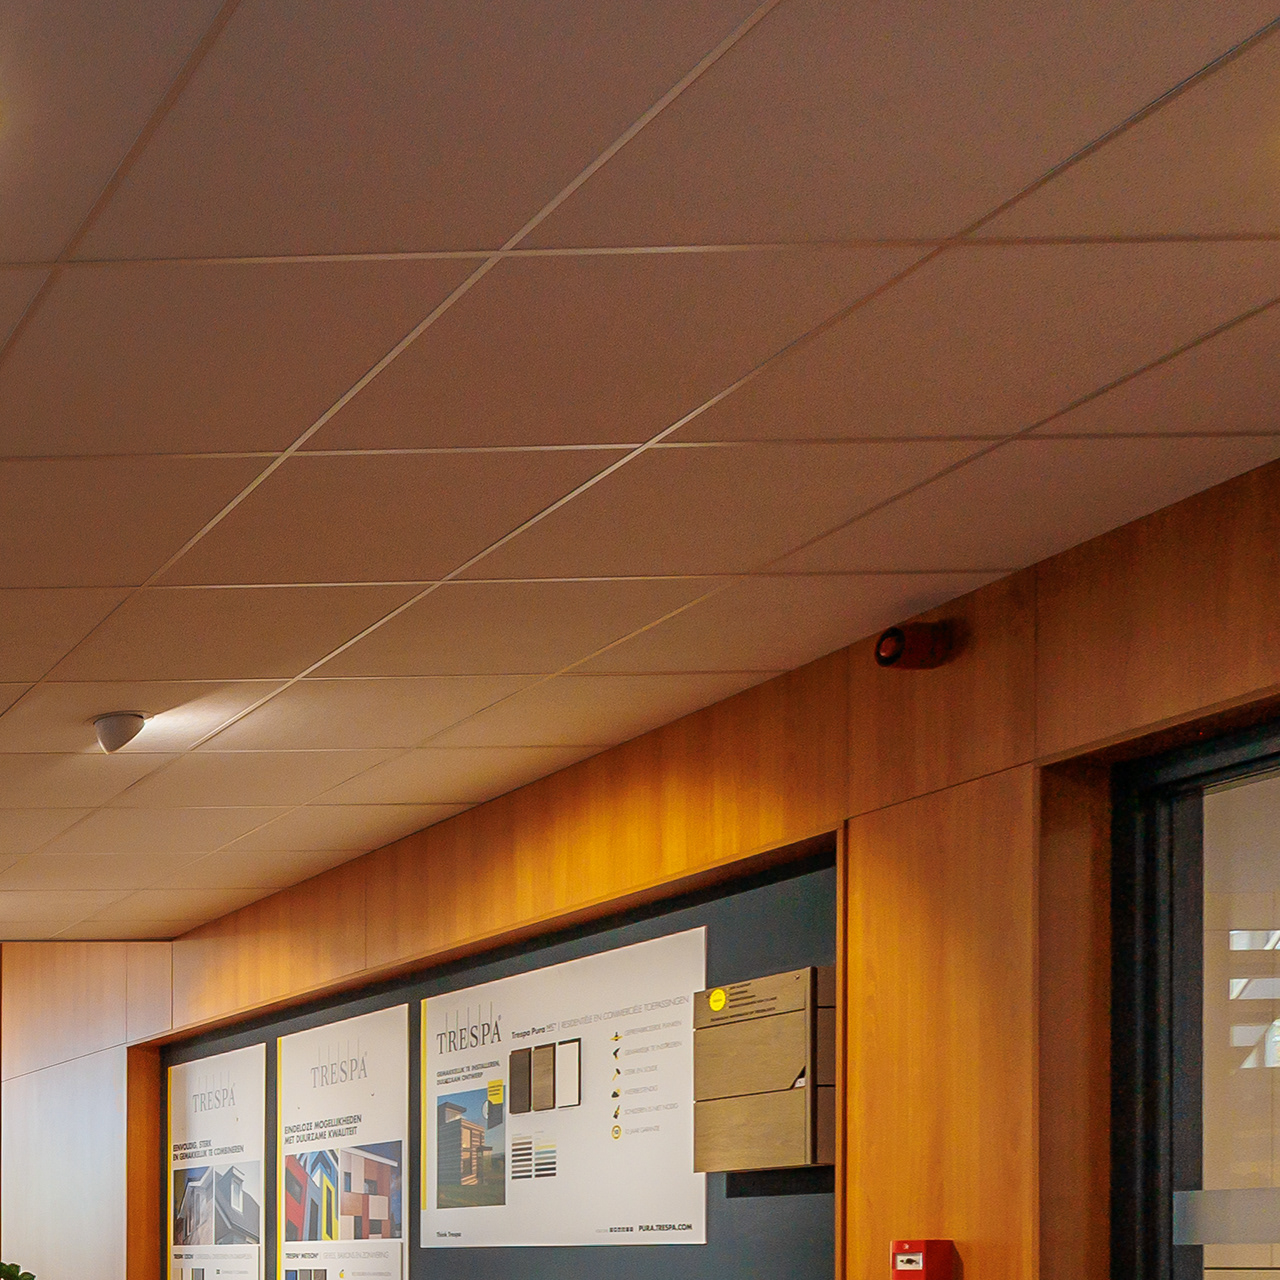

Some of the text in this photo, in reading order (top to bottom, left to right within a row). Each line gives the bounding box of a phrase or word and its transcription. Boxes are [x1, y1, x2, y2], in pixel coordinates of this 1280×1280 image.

[437, 1020, 501, 1055] TRESPA
[311, 1056, 368, 1089] TRESPA
[193, 1086, 236, 1113] TRESPA
[284, 1122, 313, 1135] EINDELOZE
[284, 1125, 358, 1145] MET DUURZAME KWALITEIT
[638, 1223, 693, 1232] PURA.TRESPA.COM
